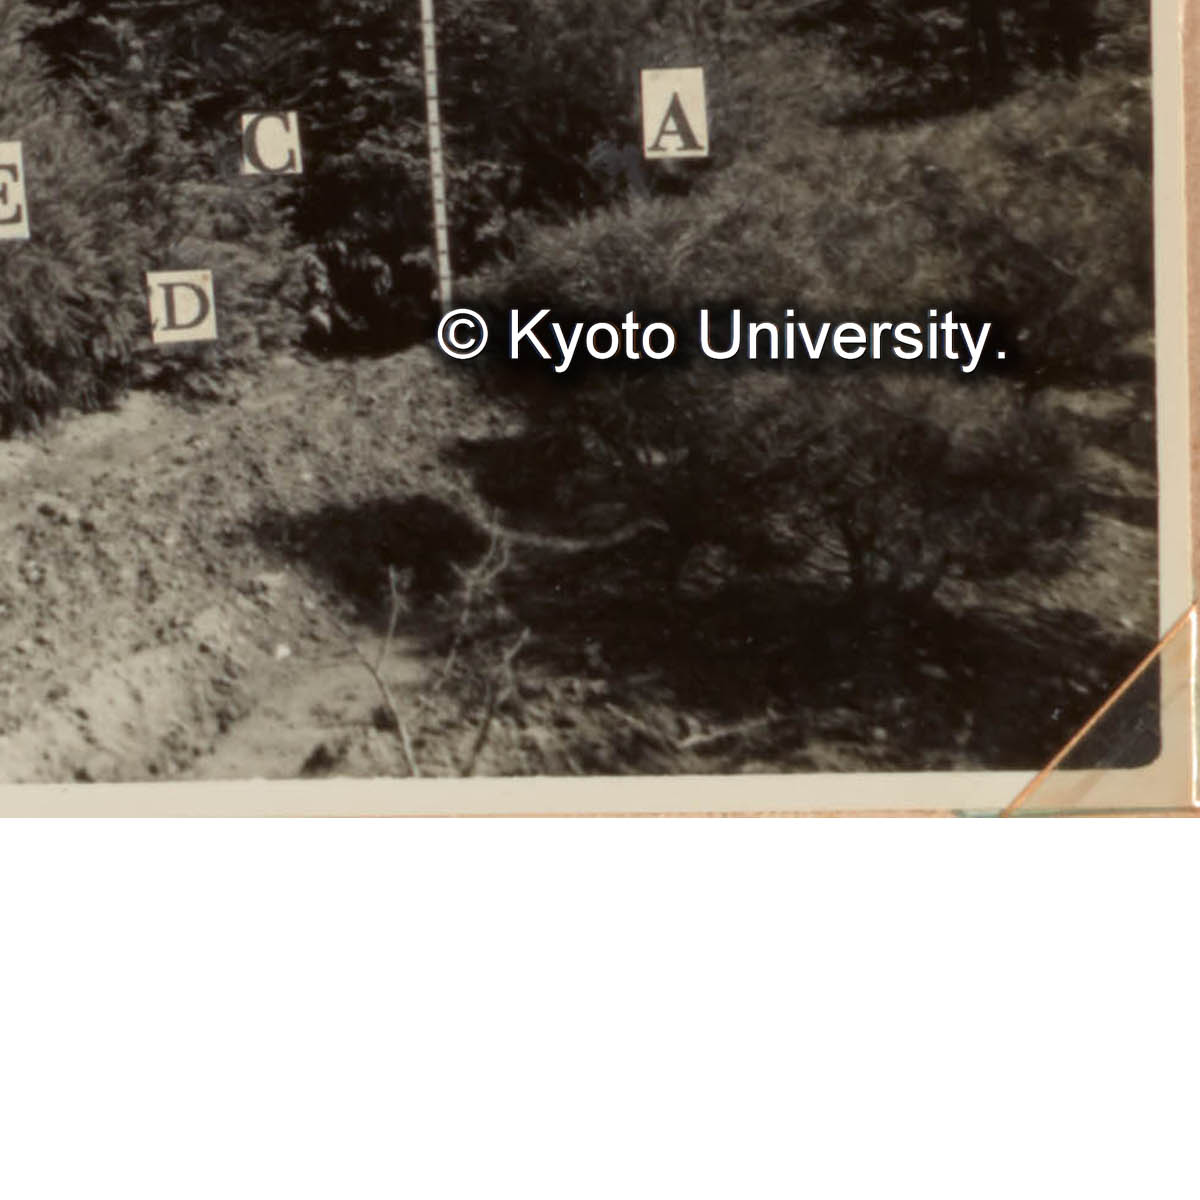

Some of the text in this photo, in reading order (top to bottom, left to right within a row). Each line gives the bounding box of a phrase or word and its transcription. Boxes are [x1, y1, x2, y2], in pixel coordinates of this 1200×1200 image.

[244, 112, 298, 174] C
[647, 91, 704, 151] A
[157, 281, 211, 332] D
